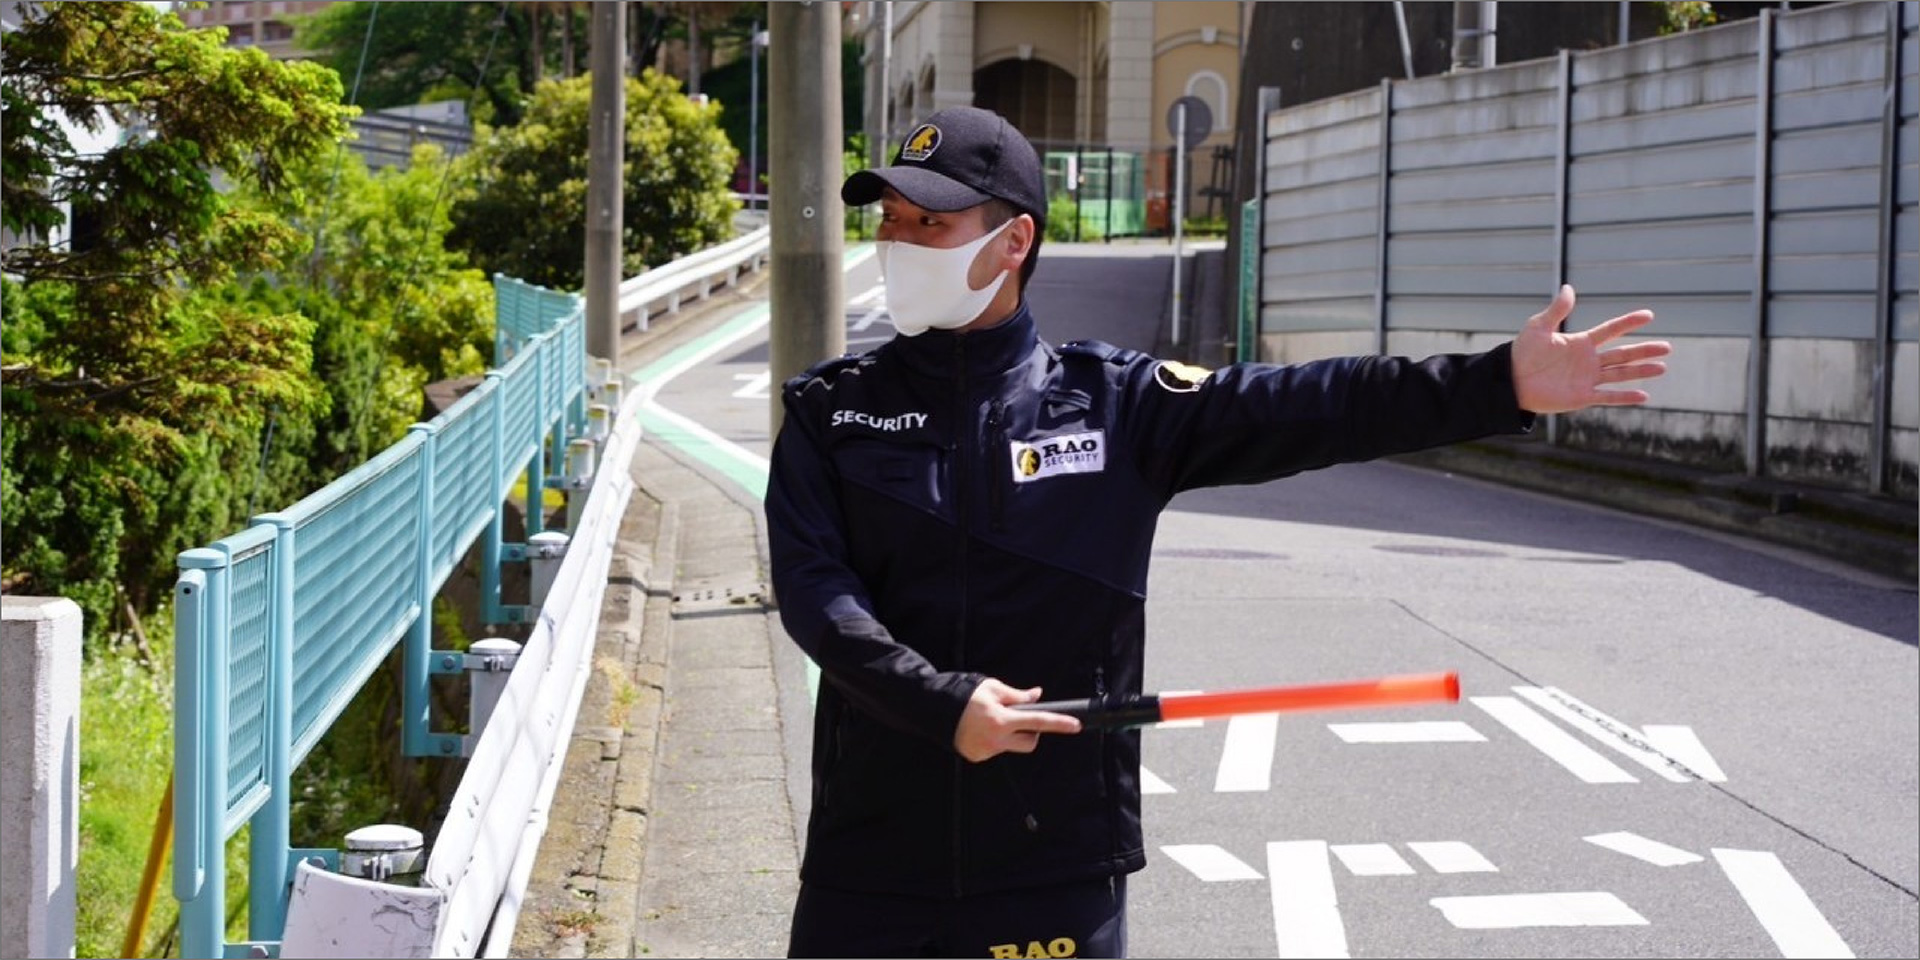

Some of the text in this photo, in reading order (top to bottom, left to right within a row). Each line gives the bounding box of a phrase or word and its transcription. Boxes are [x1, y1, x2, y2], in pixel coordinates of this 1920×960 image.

[831, 409, 928, 432] SECURITY
[1042, 439, 1097, 458] RAO
[1044, 452, 1099, 468] SECURITY
[989, 937, 1076, 958] RAO
